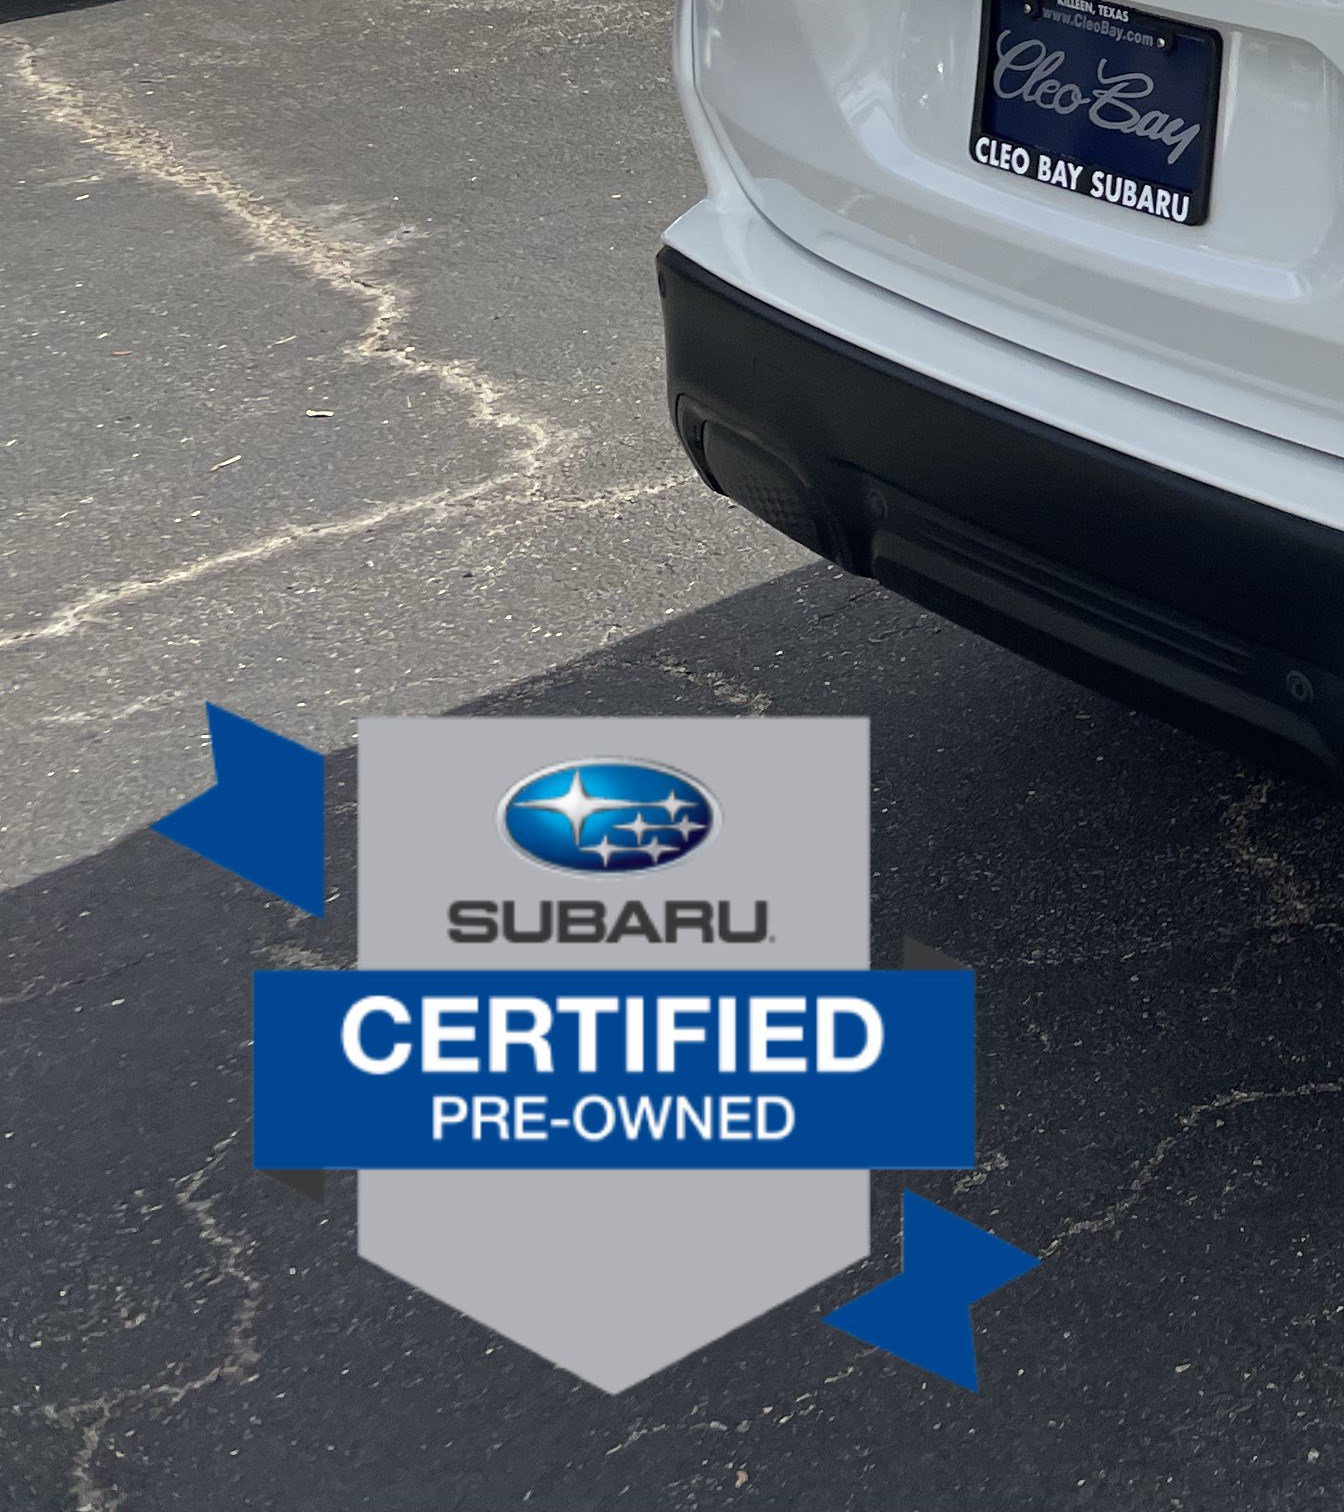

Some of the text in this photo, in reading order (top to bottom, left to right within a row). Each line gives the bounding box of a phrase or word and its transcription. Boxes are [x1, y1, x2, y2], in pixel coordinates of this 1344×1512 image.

[1042, 6, 1154, 48] www.CleoBay.com
[1098, 4, 1129, 23] TEXAS
[993, 29, 1201, 165] Cleo Bay
[975, 137, 1191, 223] CLEO BAY SUBARU
